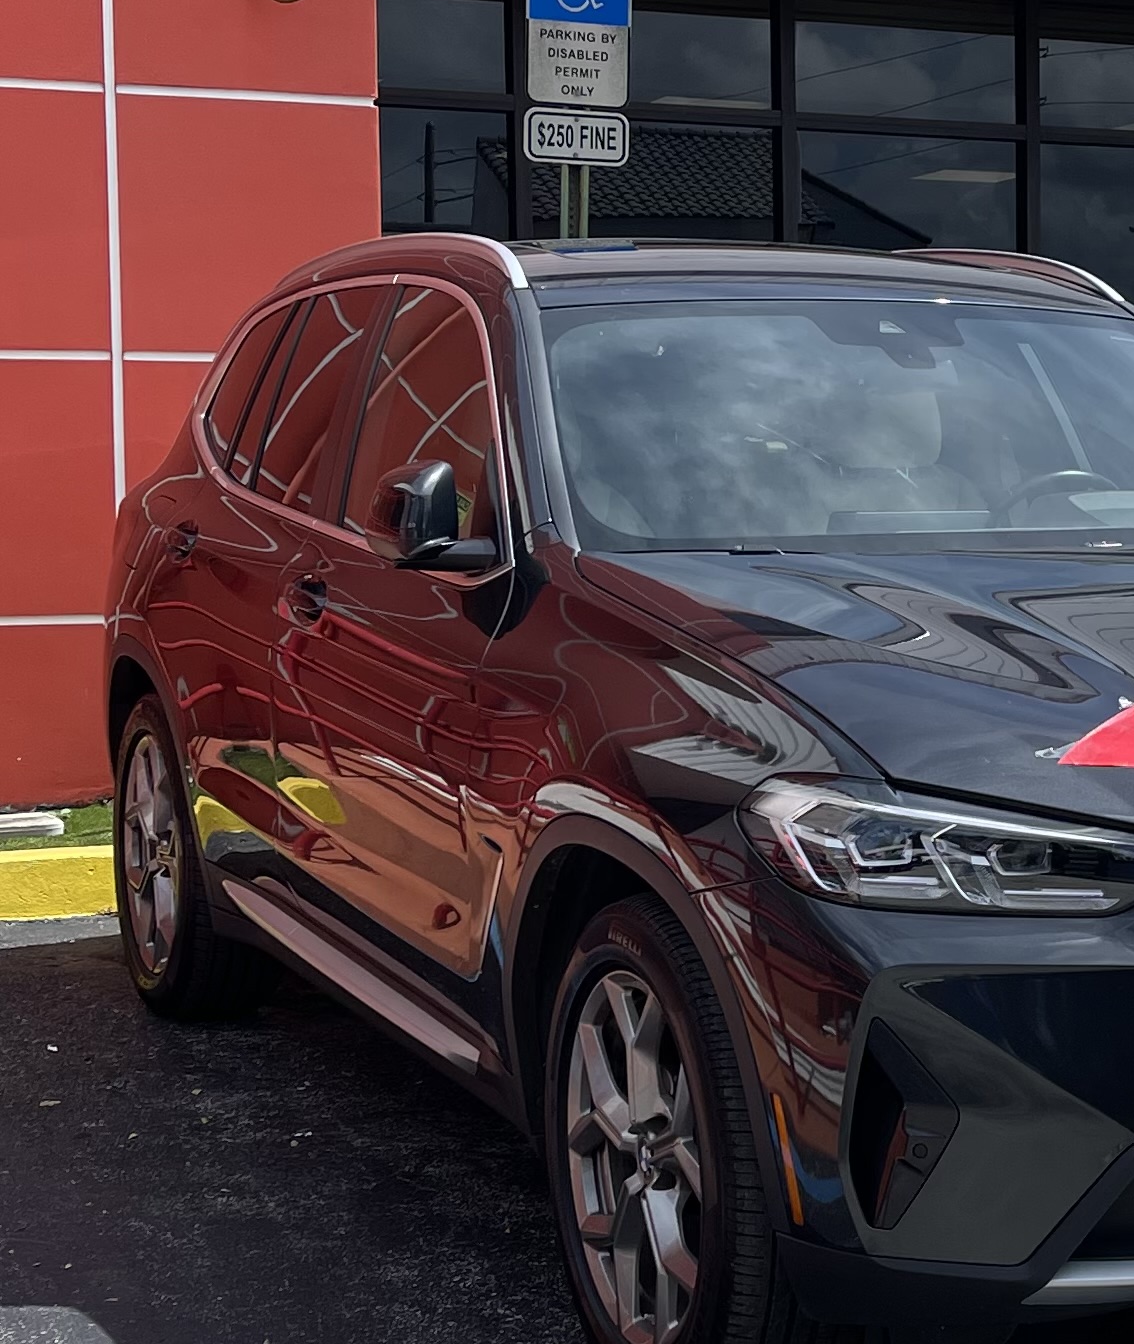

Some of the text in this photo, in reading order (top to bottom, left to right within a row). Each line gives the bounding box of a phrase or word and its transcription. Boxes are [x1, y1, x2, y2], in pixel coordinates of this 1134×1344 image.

[539, 28, 617, 44] PARKING BY
[547, 47, 609, 62] DISABLED
[554, 66, 601, 80] PERMIT
[560, 84, 595, 97] ONLY
[537, 120, 617, 151] $250 FINE
